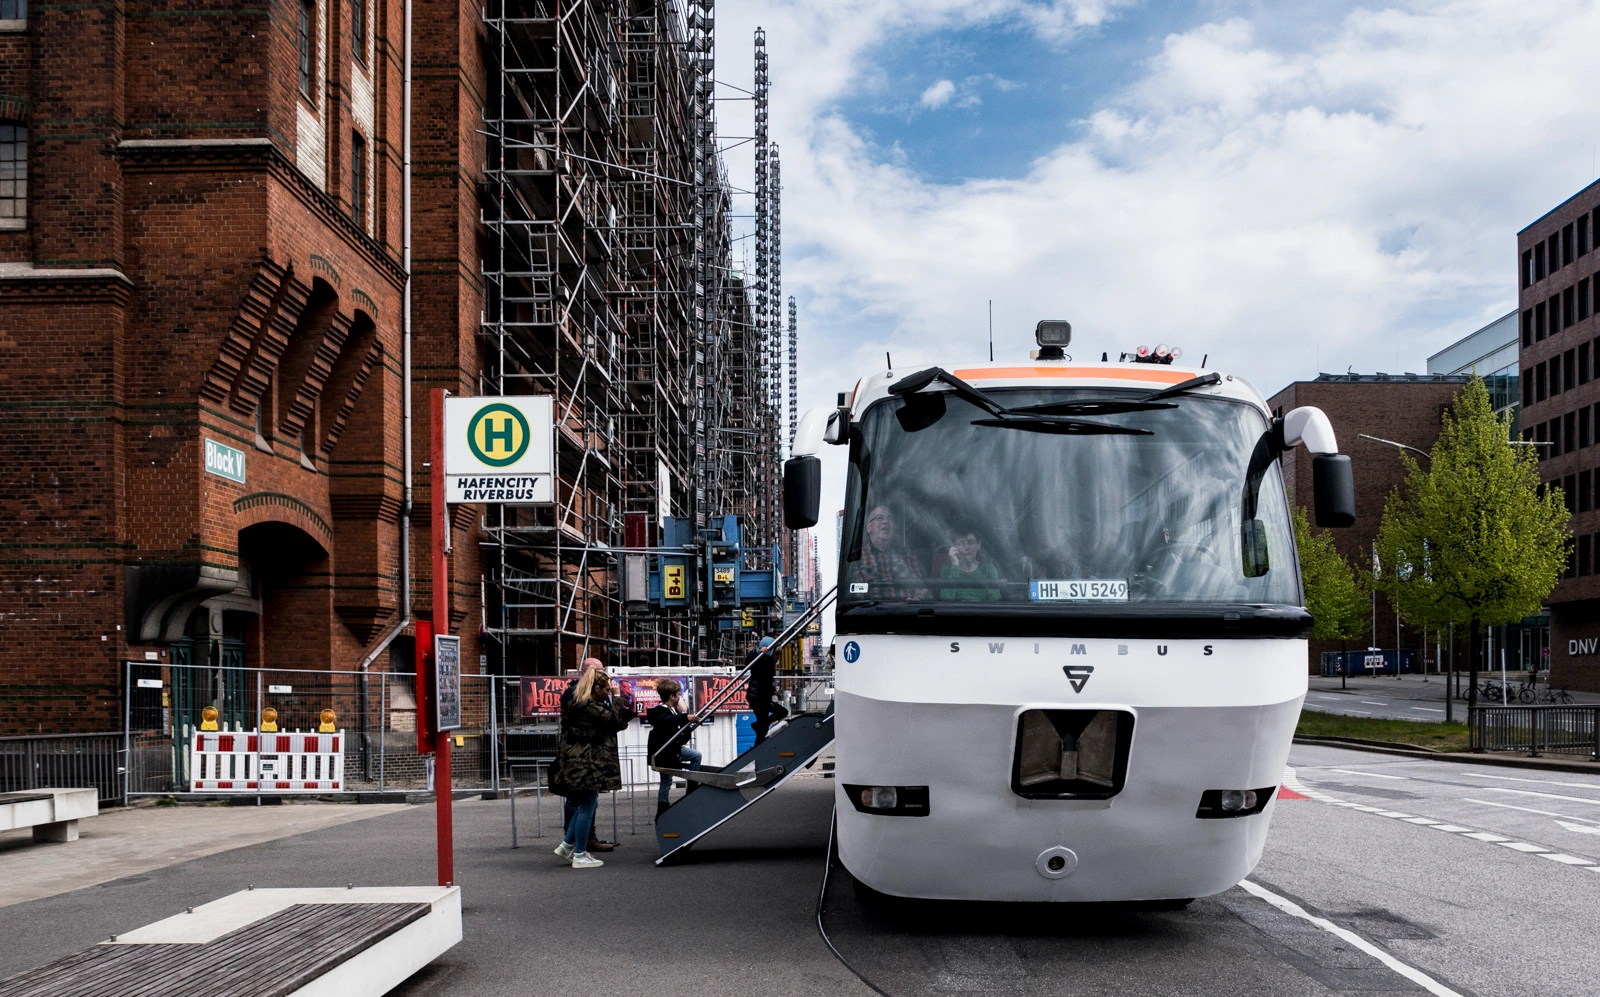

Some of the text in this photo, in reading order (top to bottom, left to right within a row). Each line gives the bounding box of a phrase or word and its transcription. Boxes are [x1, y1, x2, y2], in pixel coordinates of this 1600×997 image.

[484, 418, 513, 452] H
[207, 442, 242, 477] Block V
[457, 477, 539, 488] HAFENCITY
[463, 489, 533, 500] RIVERBUS
[669, 568, 680, 596] B+L
[1040, 583, 1126, 598] HH SV 5249
[950, 642, 1214, 656] SWIMBUS
[1568, 638, 1598, 655] DNV
